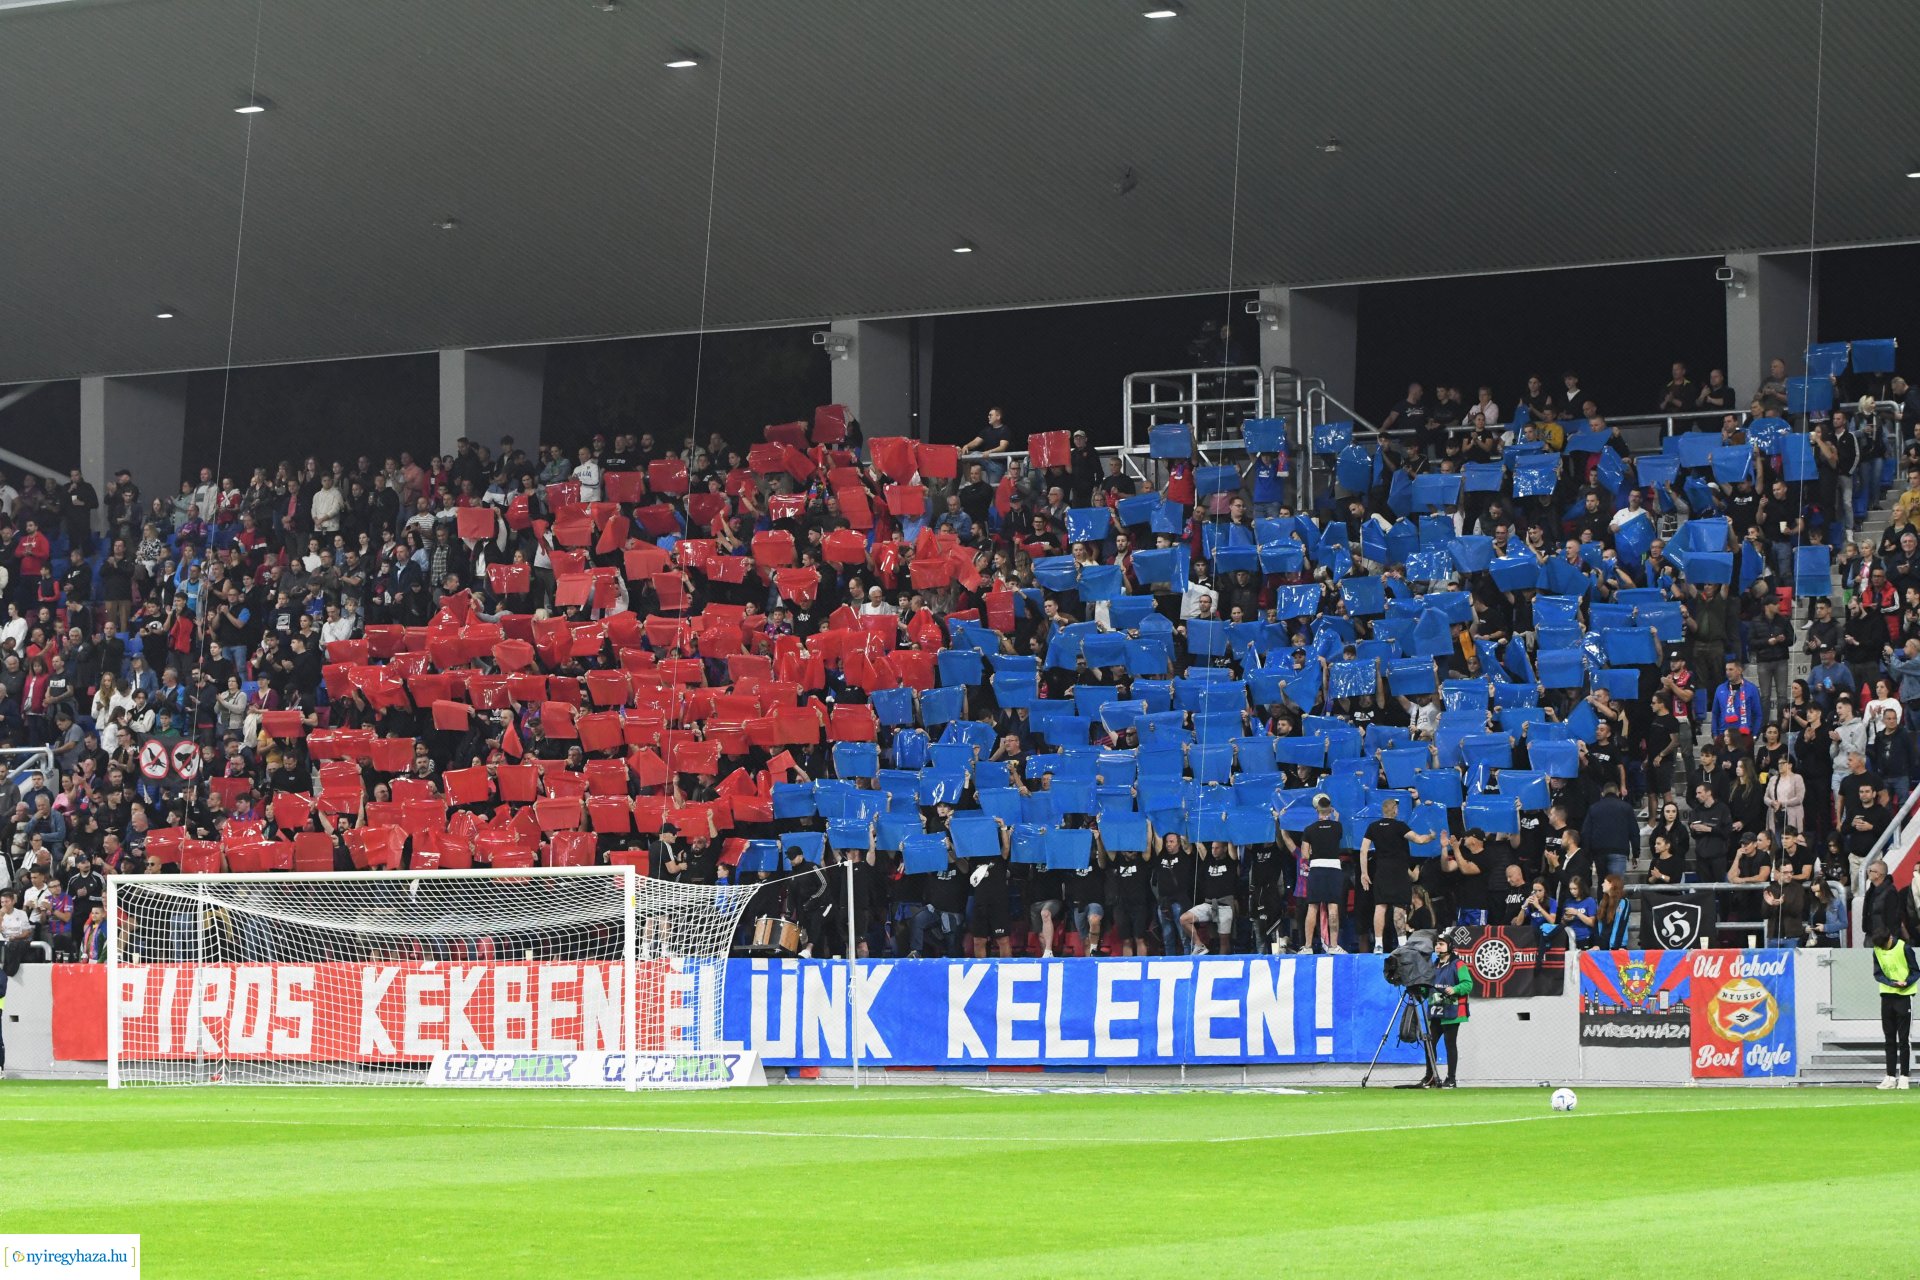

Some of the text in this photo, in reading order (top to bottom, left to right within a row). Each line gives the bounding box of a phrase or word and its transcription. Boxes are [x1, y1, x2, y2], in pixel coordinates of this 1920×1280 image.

[1797, 665, 1808, 675] 10
[1693, 951, 1790, 978] Old School
[117, 967, 315, 1055] PIROS
[358, 961, 626, 1056] KÉKBEN
[946, 956, 1334, 1060] KELETEN!
[1695, 1042, 1792, 1071] Best Style
